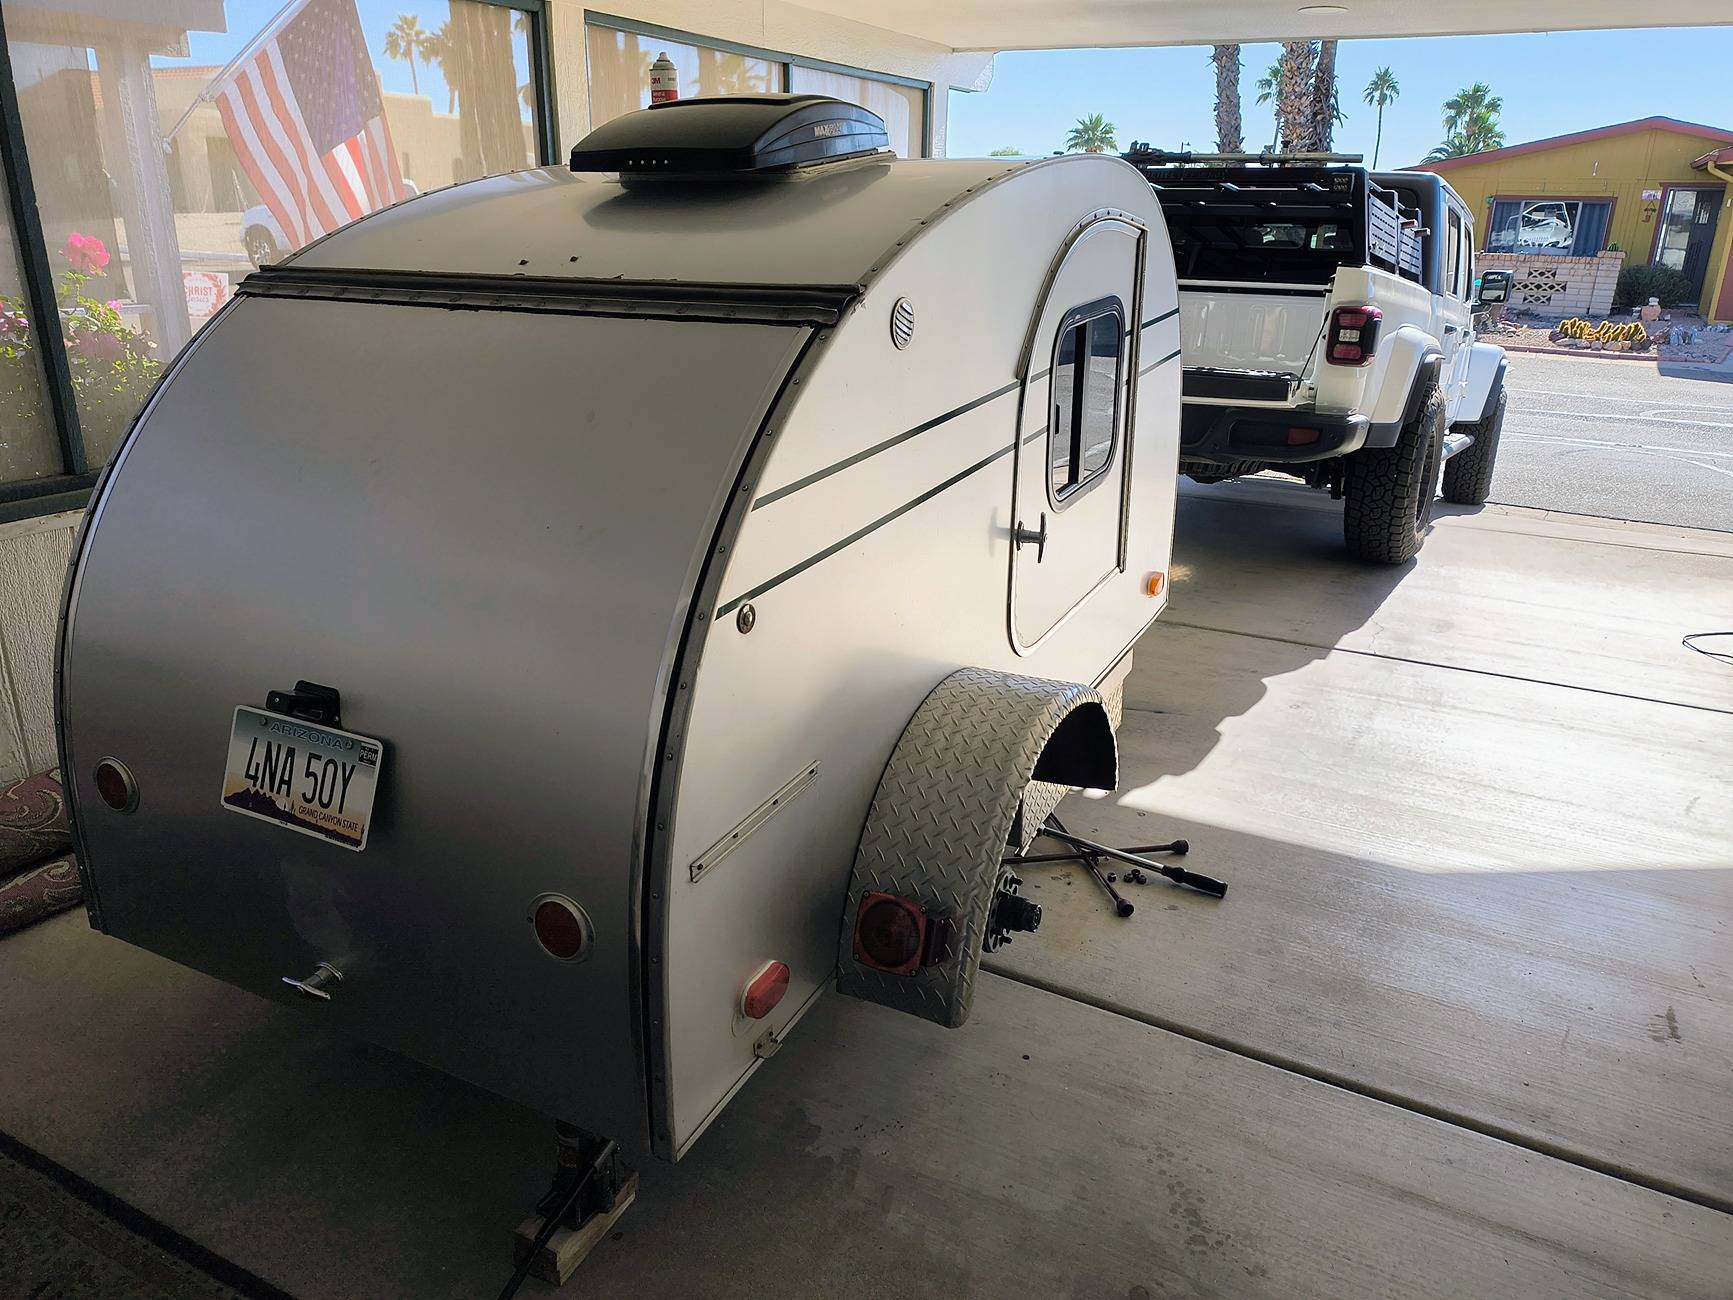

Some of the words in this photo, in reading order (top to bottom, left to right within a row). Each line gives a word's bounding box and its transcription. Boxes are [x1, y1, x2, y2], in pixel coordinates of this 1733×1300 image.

[651, 77, 661, 85] 3M
[271, 722, 343, 751] ARIZONA
[360, 750, 377, 761] PERM
[245, 737, 296, 798] 4NA
[302, 752, 356, 814] 50Y
[298, 805, 319, 819] GRAND
[318, 811, 343, 828] CANYON
[341, 819, 359, 833] STATE
